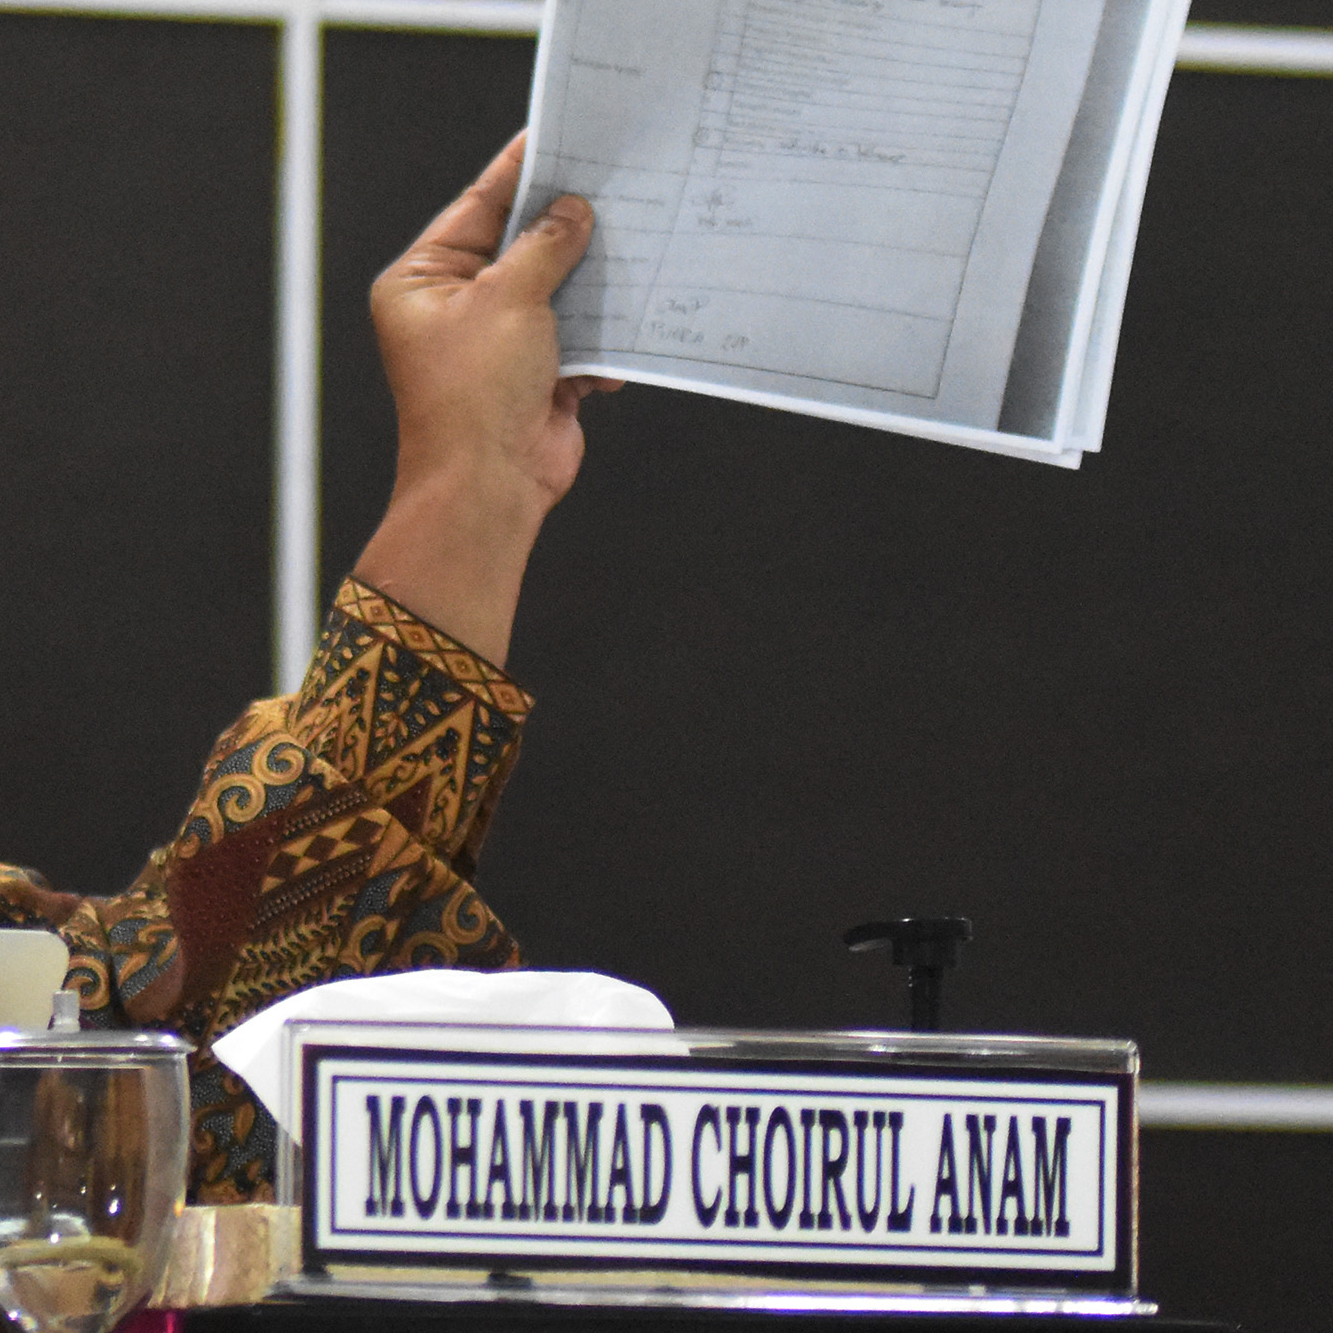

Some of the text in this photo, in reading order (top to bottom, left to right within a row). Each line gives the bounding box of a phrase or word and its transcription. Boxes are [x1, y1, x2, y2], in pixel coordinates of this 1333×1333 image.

[364, 1094, 1073, 1237] MOHAMMAD CHOIRUL ANAM
